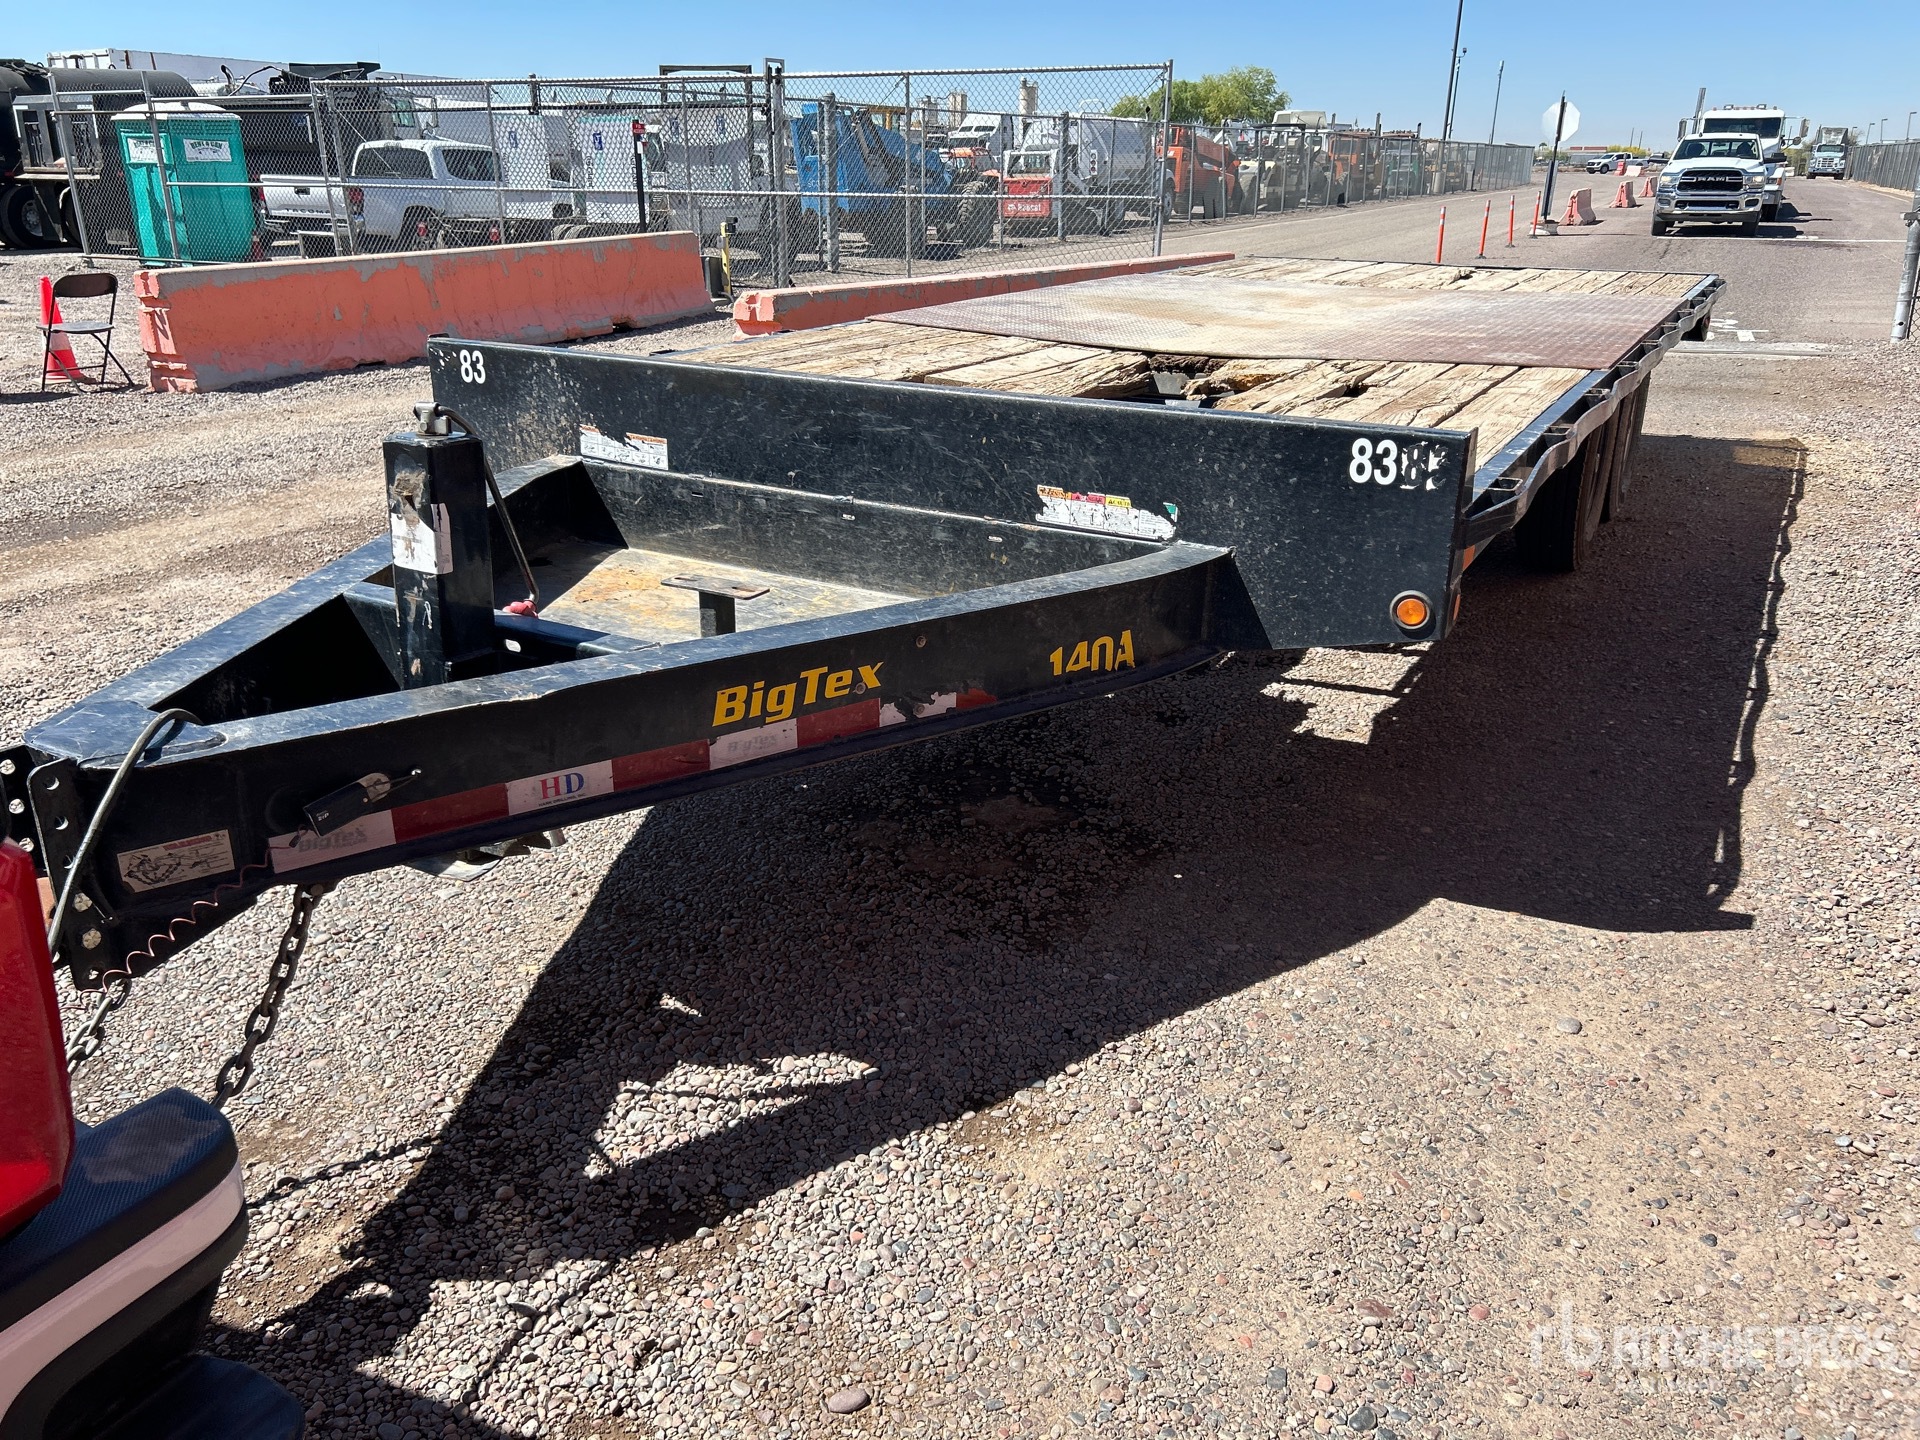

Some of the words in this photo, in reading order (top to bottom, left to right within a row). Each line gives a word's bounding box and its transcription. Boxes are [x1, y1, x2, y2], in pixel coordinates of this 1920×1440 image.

[459, 349, 486, 384] 83
[1349, 437, 1398, 485] 83
[712, 661, 884, 727] BigTex
[540, 772, 585, 799] HD
